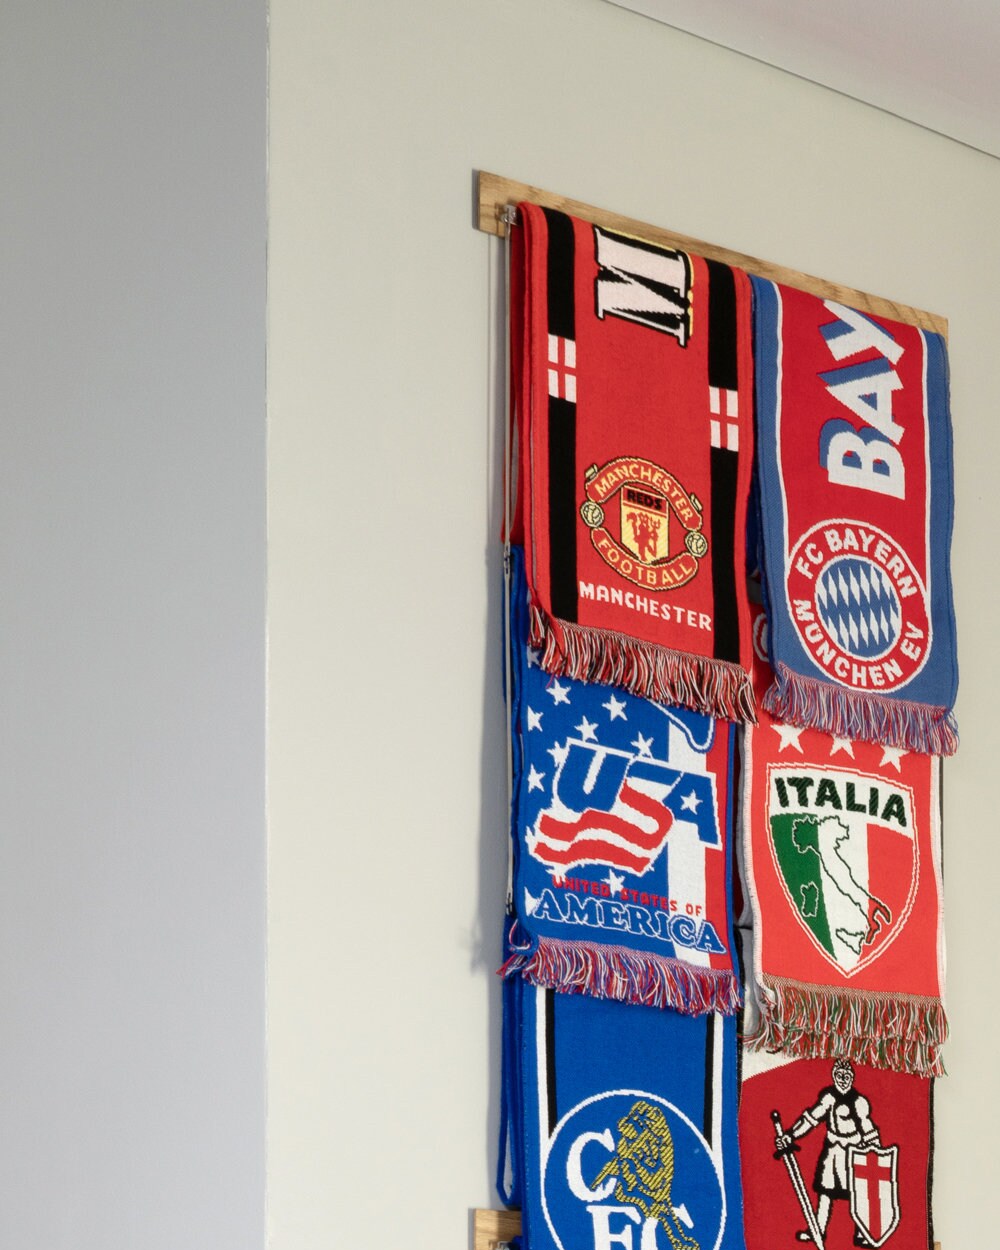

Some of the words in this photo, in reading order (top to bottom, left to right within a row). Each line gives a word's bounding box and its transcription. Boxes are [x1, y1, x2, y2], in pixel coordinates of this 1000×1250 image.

[594, 463, 694, 522] MANCHESTER
[626, 488, 663, 511] REDS
[597, 537, 693, 586] FOOTBALL
[795, 543, 824, 580] FC
[823, 527, 918, 599] BAYERN
[578, 580, 713, 632] MANCHESTER
[543, 738, 723, 866] USA
[774, 776, 909, 828] ITALIA
[533, 888, 727, 954] AMERICA
[552, 873, 611, 899] UNITED
[618, 889, 678, 912] STATES
[685, 903, 703, 917] OF
